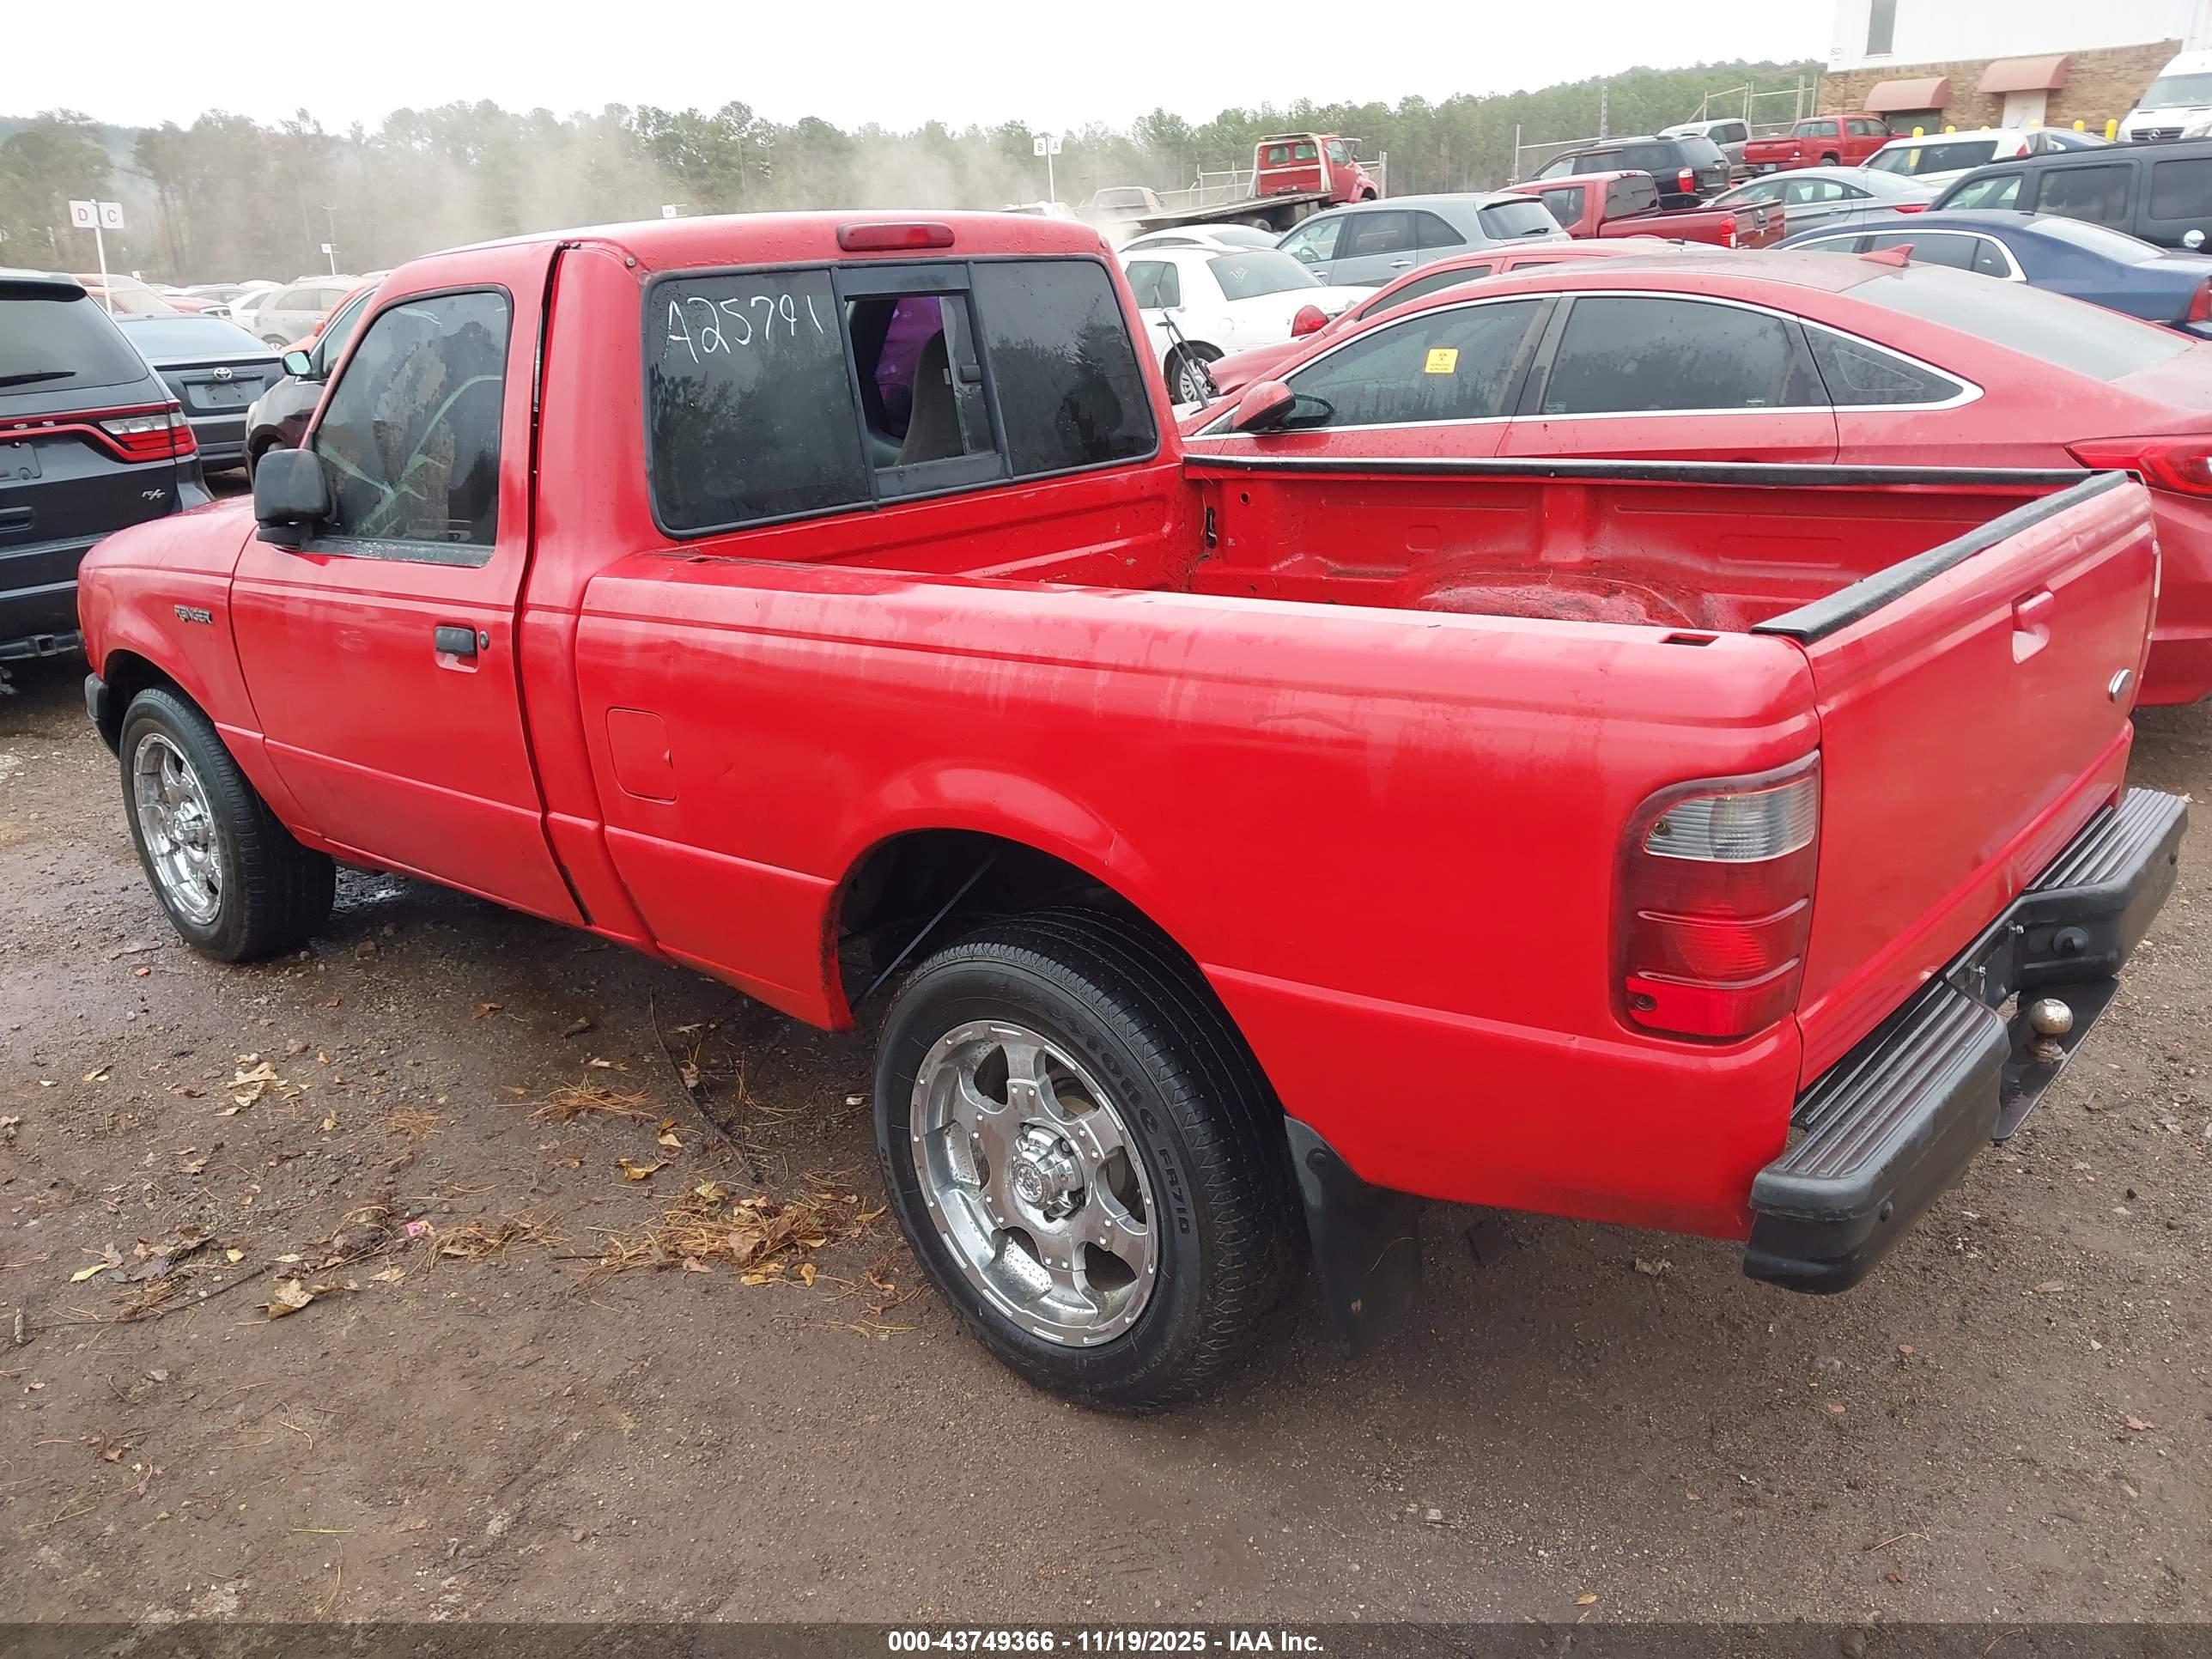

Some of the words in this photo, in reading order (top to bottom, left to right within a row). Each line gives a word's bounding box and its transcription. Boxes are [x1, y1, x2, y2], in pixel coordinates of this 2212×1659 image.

[77, 208, 88, 222] D
[107, 209, 118, 222] C
[142, 489, 166, 501] R/T
[1158, 1147, 1192, 1235] FR710
